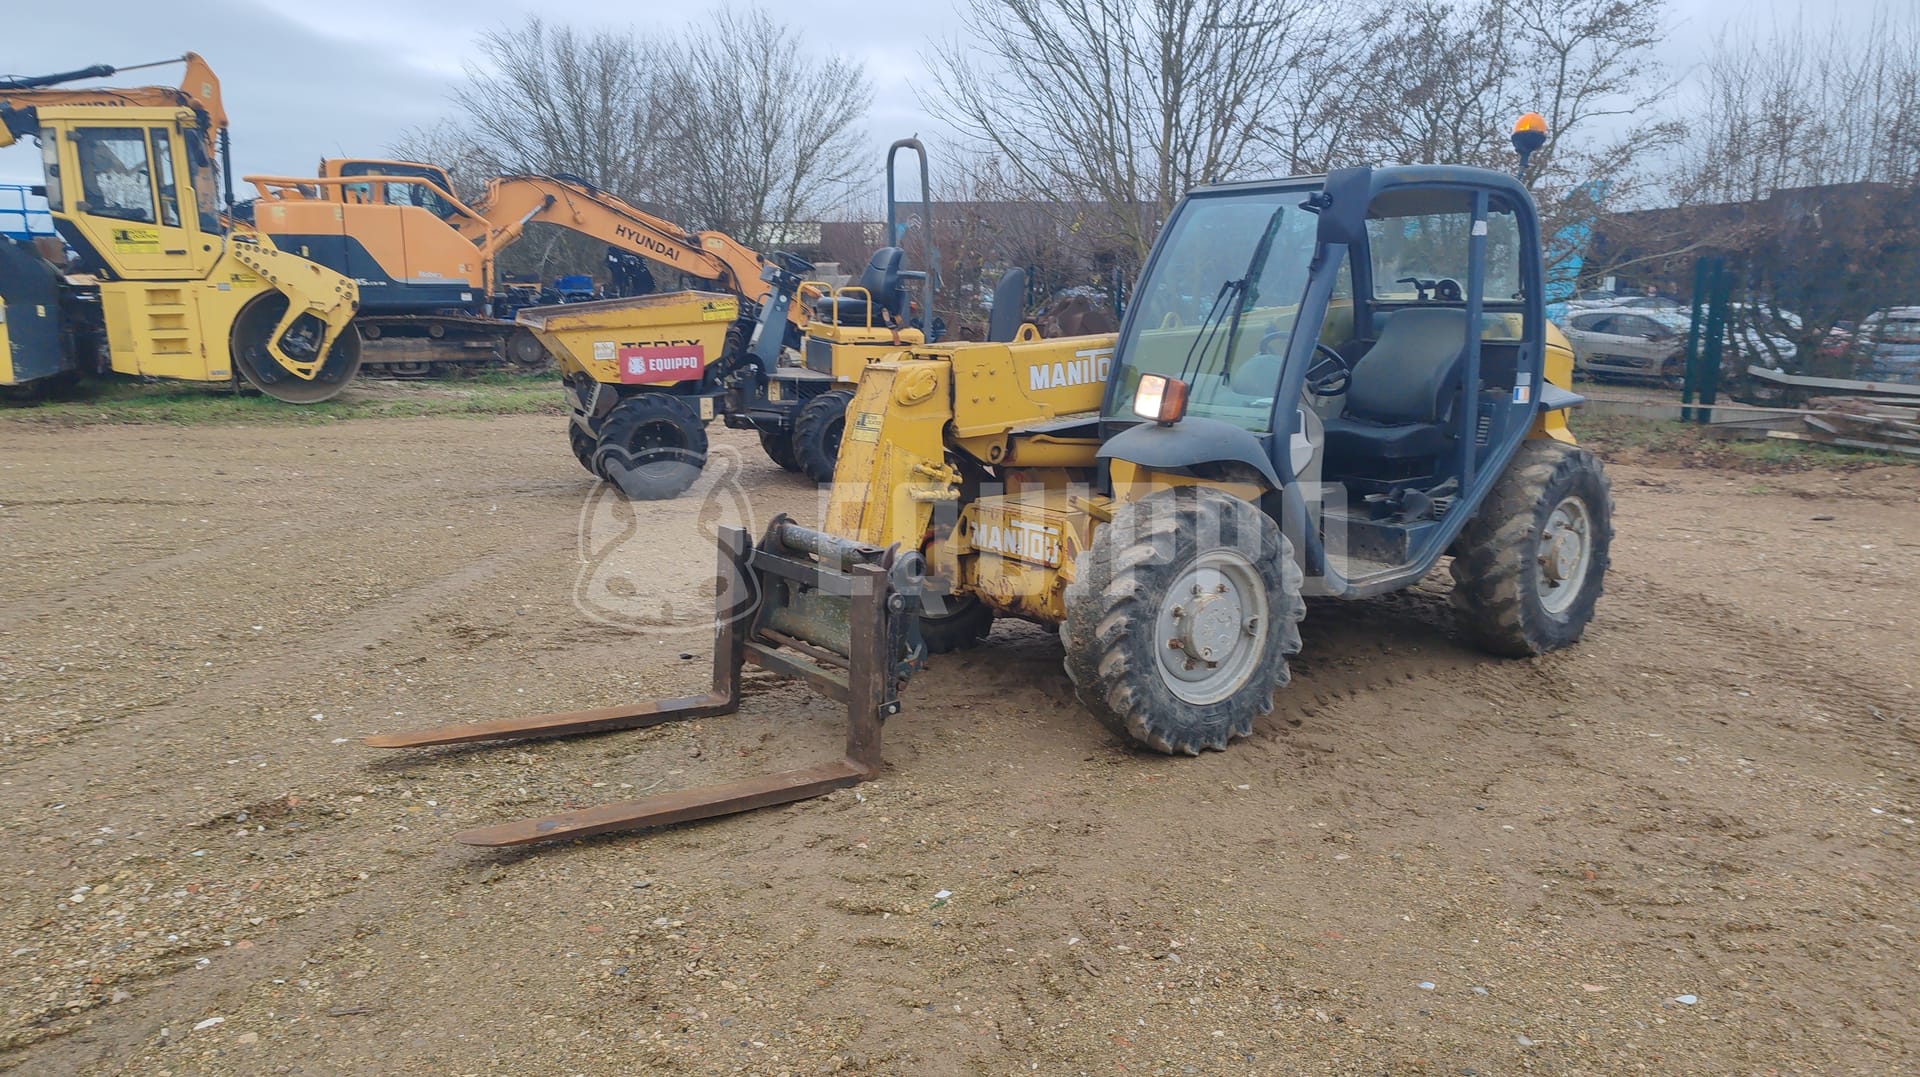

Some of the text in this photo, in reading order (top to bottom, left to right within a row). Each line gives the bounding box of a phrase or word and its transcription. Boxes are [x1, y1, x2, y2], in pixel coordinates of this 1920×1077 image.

[615, 223, 680, 261] HYUNDAI
[648, 356, 698, 372] EQUIPPO
[1029, 348, 1115, 391] MANITO
[971, 519, 1061, 564] MANITOU
